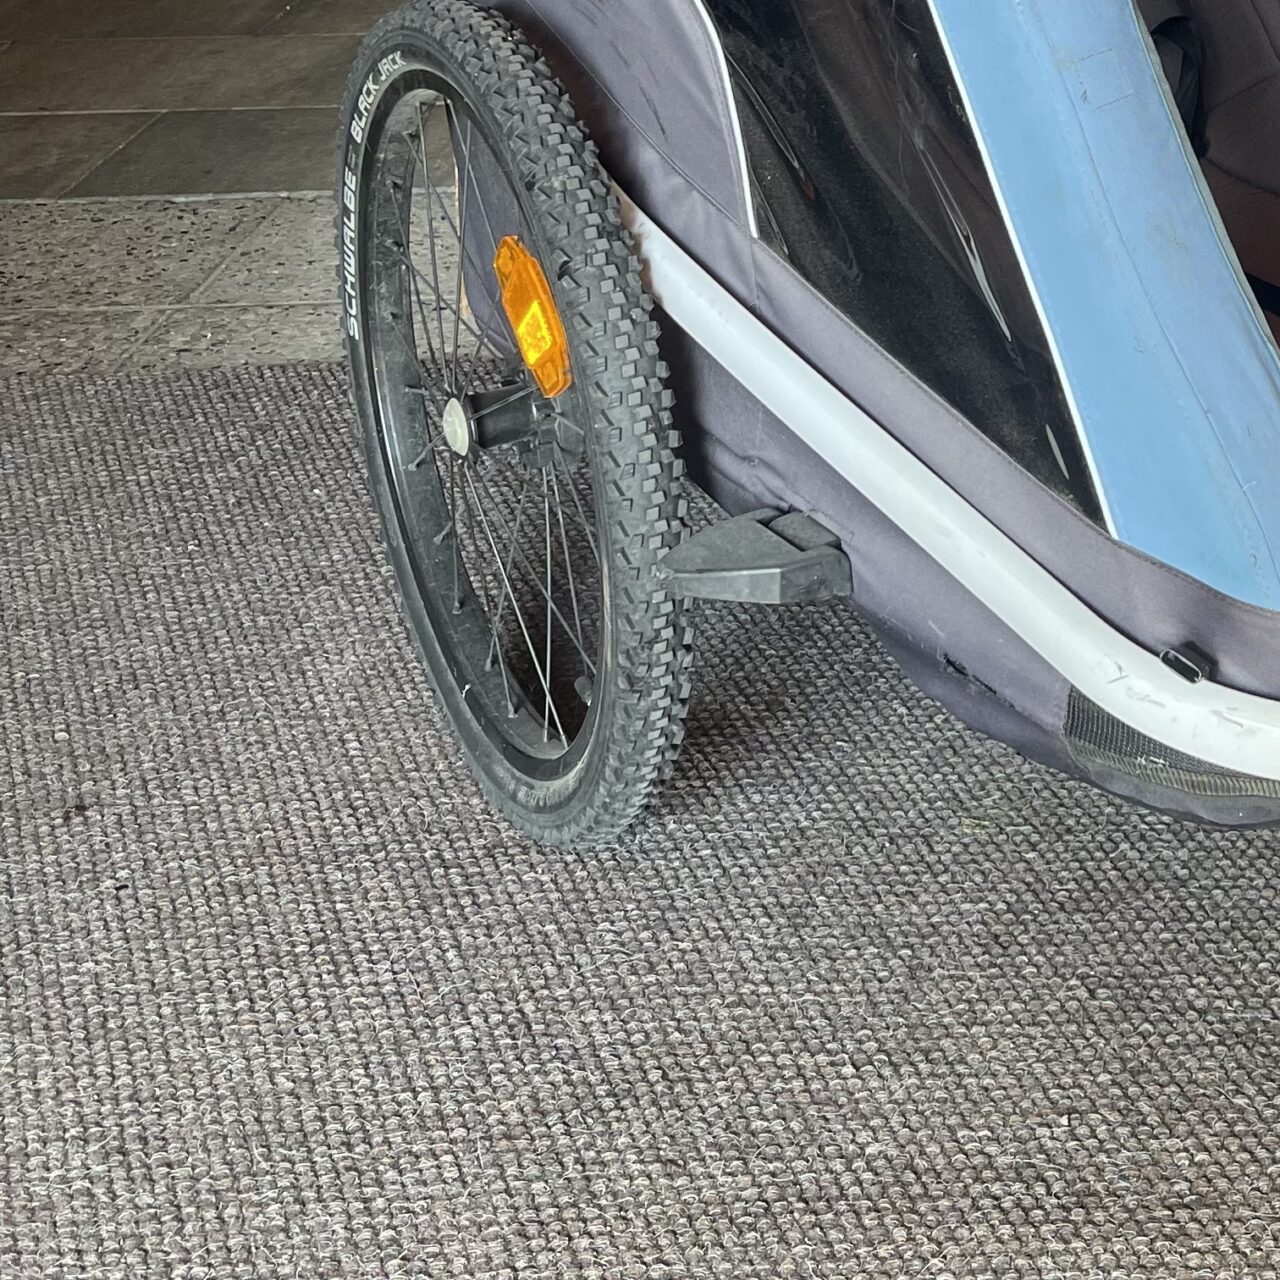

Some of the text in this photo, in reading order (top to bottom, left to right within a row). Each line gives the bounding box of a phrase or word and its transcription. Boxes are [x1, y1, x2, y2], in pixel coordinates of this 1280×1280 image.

[343, 50, 407, 341] SCHWALBE BLACK JACK
